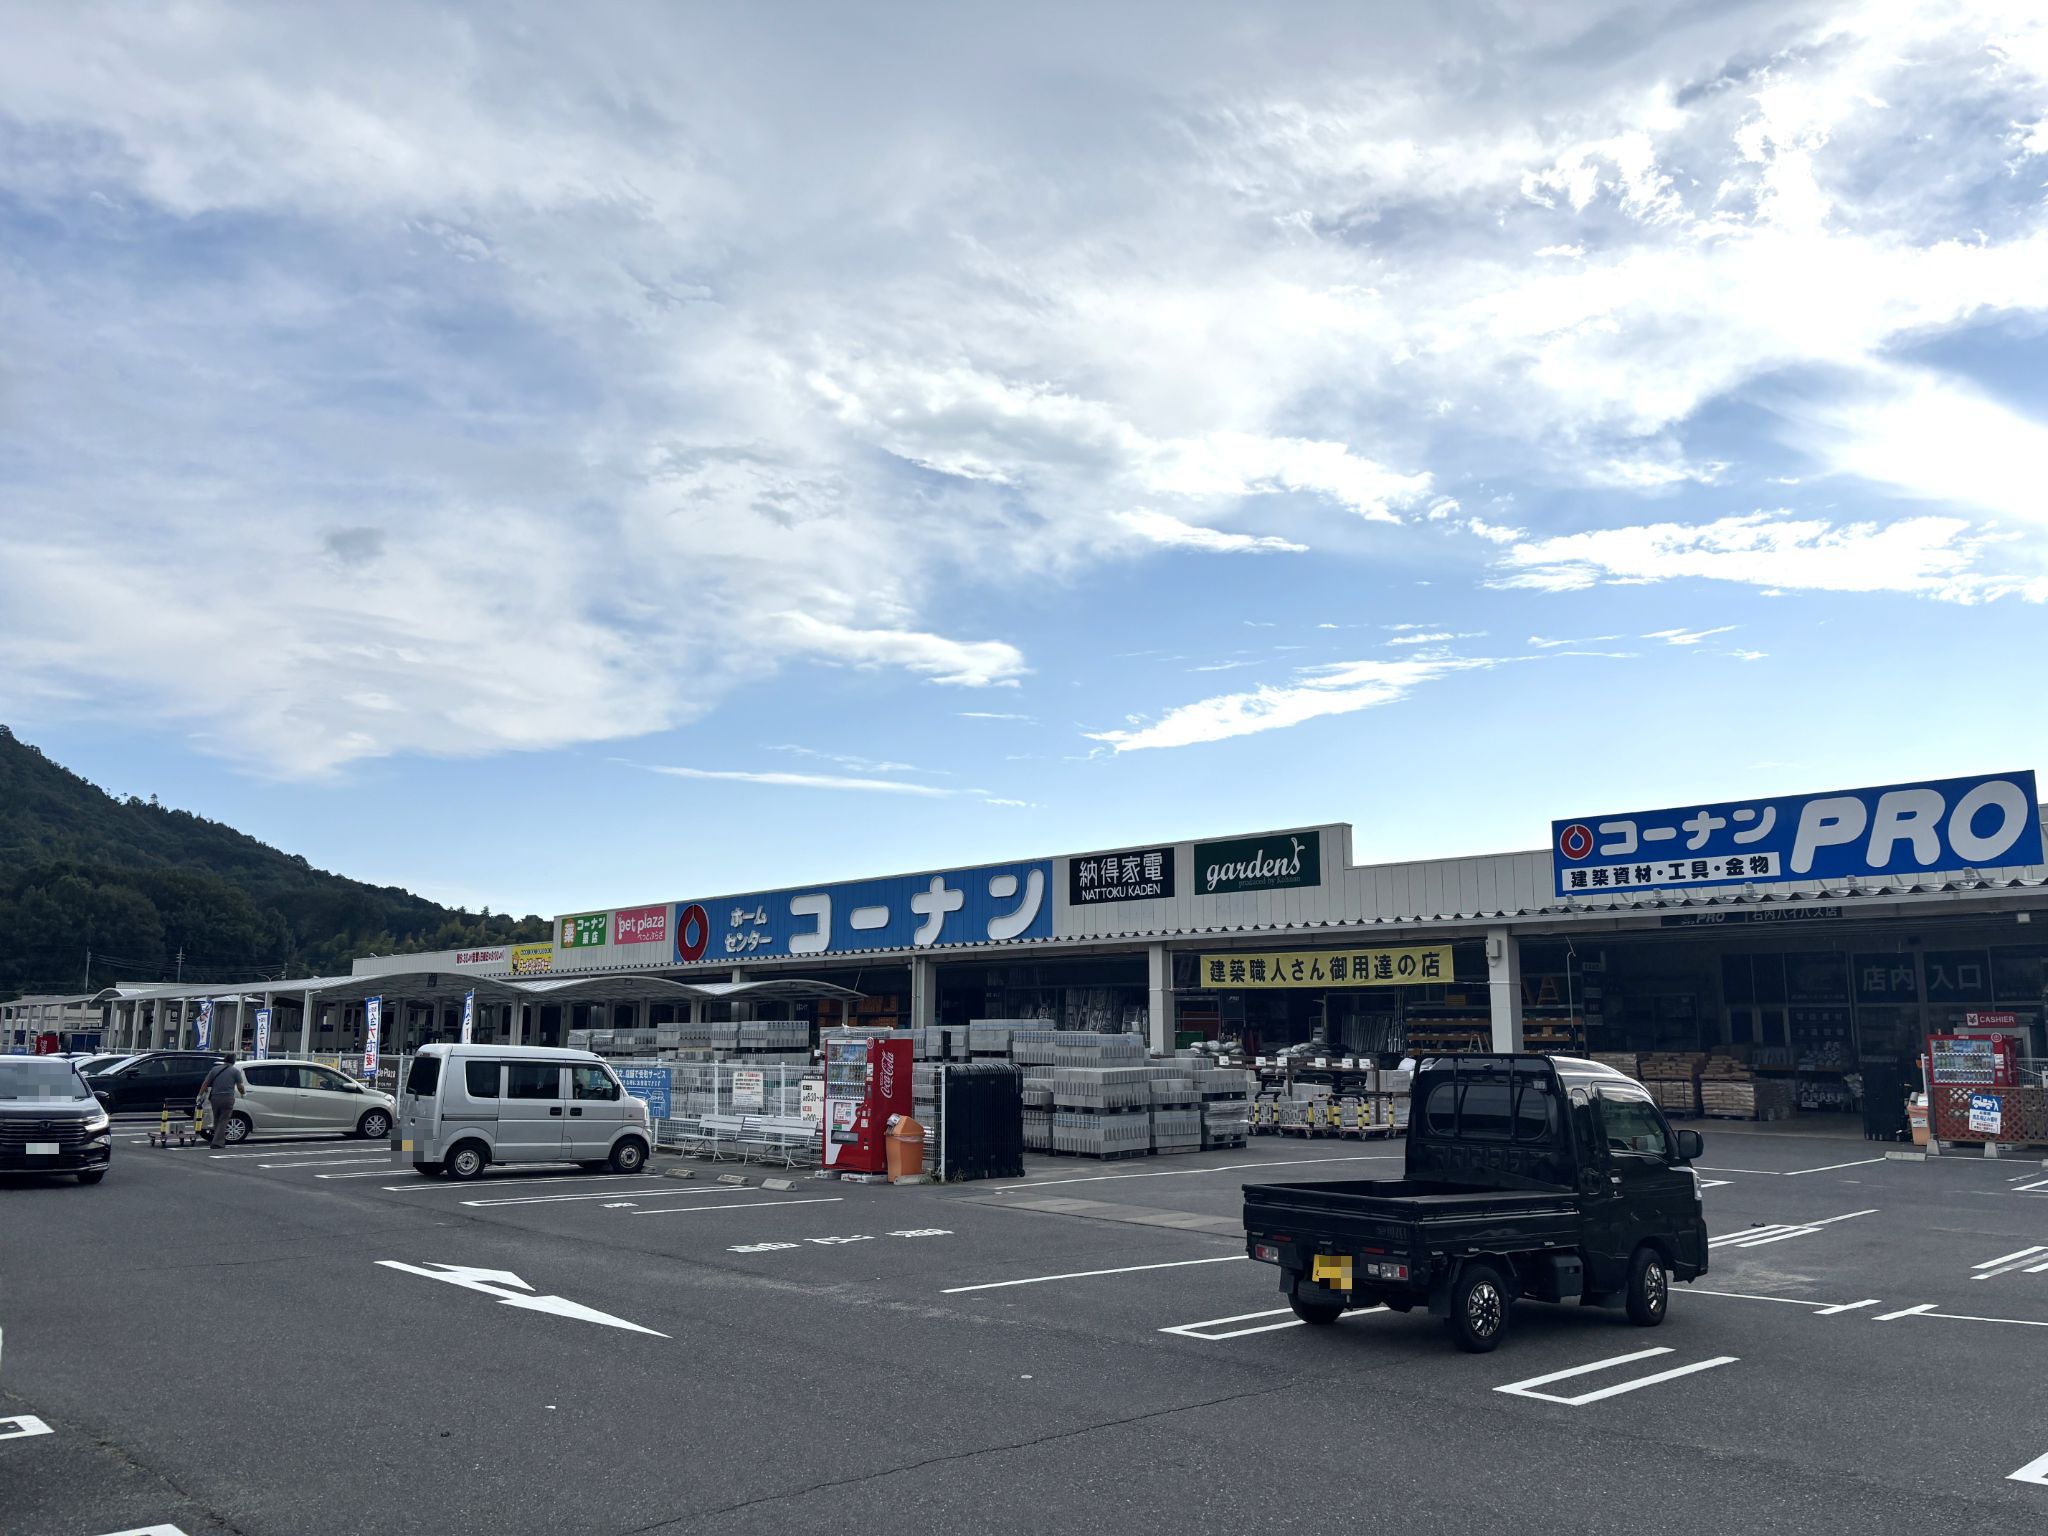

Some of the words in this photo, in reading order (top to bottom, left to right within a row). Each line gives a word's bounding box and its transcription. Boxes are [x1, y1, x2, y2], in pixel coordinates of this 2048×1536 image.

[1599, 805, 1777, 857] コーナン
[1790, 780, 2028, 874] PRO
[1079, 852, 1163, 888] 納得家電
[1206, 837, 1305, 891] gardens
[1571, 856, 1769, 887] 建築資材・工具・金物
[1082, 886, 1126, 901] NATTOKU
[1128, 883, 1161, 896] KADEN
[577, 917, 606, 931] コーナン
[730, 905, 768, 927] ホーム
[788, 868, 1045, 954] コーナン
[617, 916, 636, 941] pet
[637, 912, 665, 934] plaza
[724, 933, 773, 953] センター
[1210, 953, 1441, 983] 建築職人さん御用達の店
[1931, 963, 1984, 991] 入口
[1979, 1014, 2015, 1024] CASHIER
[880, 1050, 895, 1099] Coca-Cola
